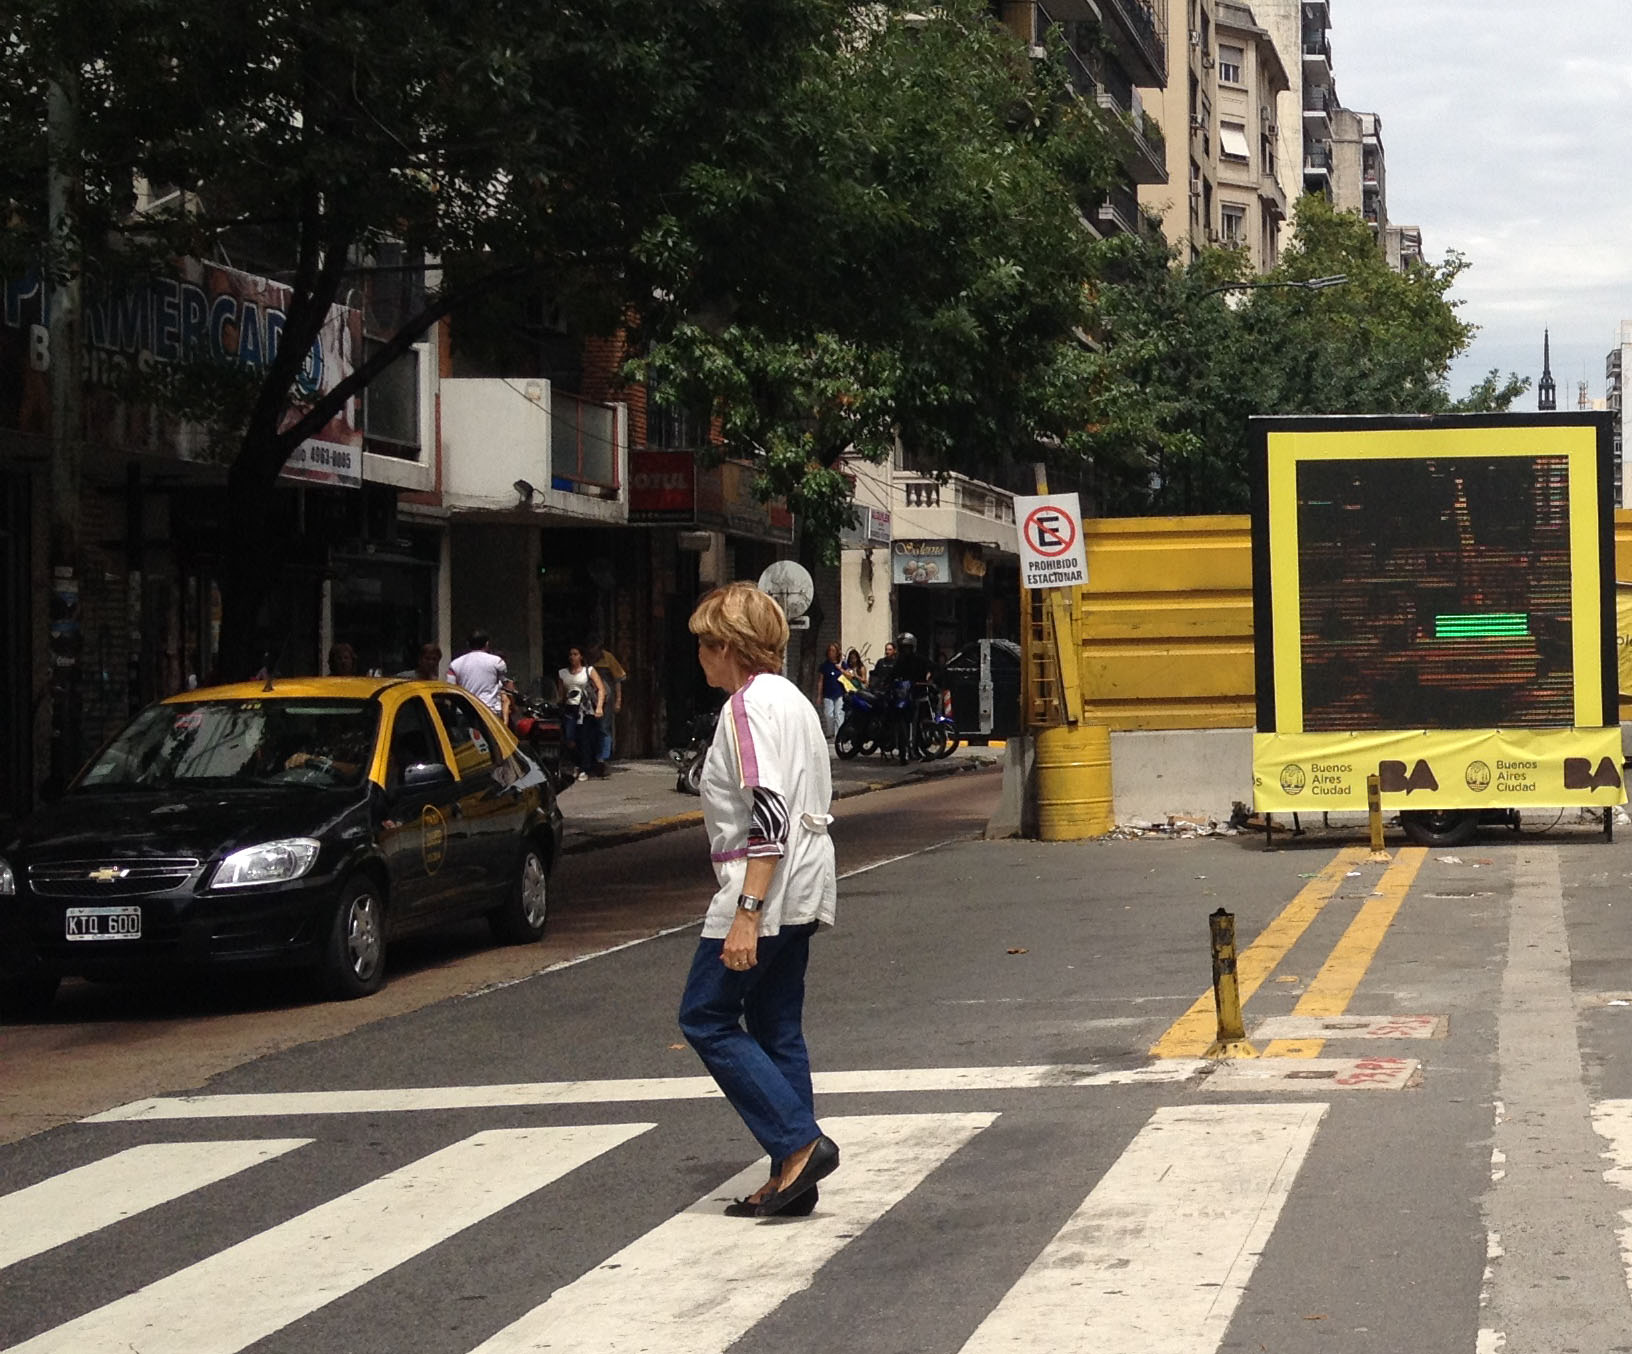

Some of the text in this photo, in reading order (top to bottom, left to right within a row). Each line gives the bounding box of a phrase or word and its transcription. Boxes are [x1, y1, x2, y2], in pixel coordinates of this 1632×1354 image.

[1028, 557, 1078, 572] PROHIBIDO
[1027, 570, 1083, 585] ESTACIONAR
[1311, 763, 1353, 773] Buenos
[1496, 760, 1537, 769] Buenos
[1312, 775, 1342, 784] Aires
[1378, 758, 1439, 796] BA
[1496, 771, 1527, 780] Aires
[1563, 756, 1621, 793] BA
[1311, 785, 1352, 795] Ciudad
[1496, 782, 1536, 792] Ciudad
[69, 915, 138, 934] KTQ 600
